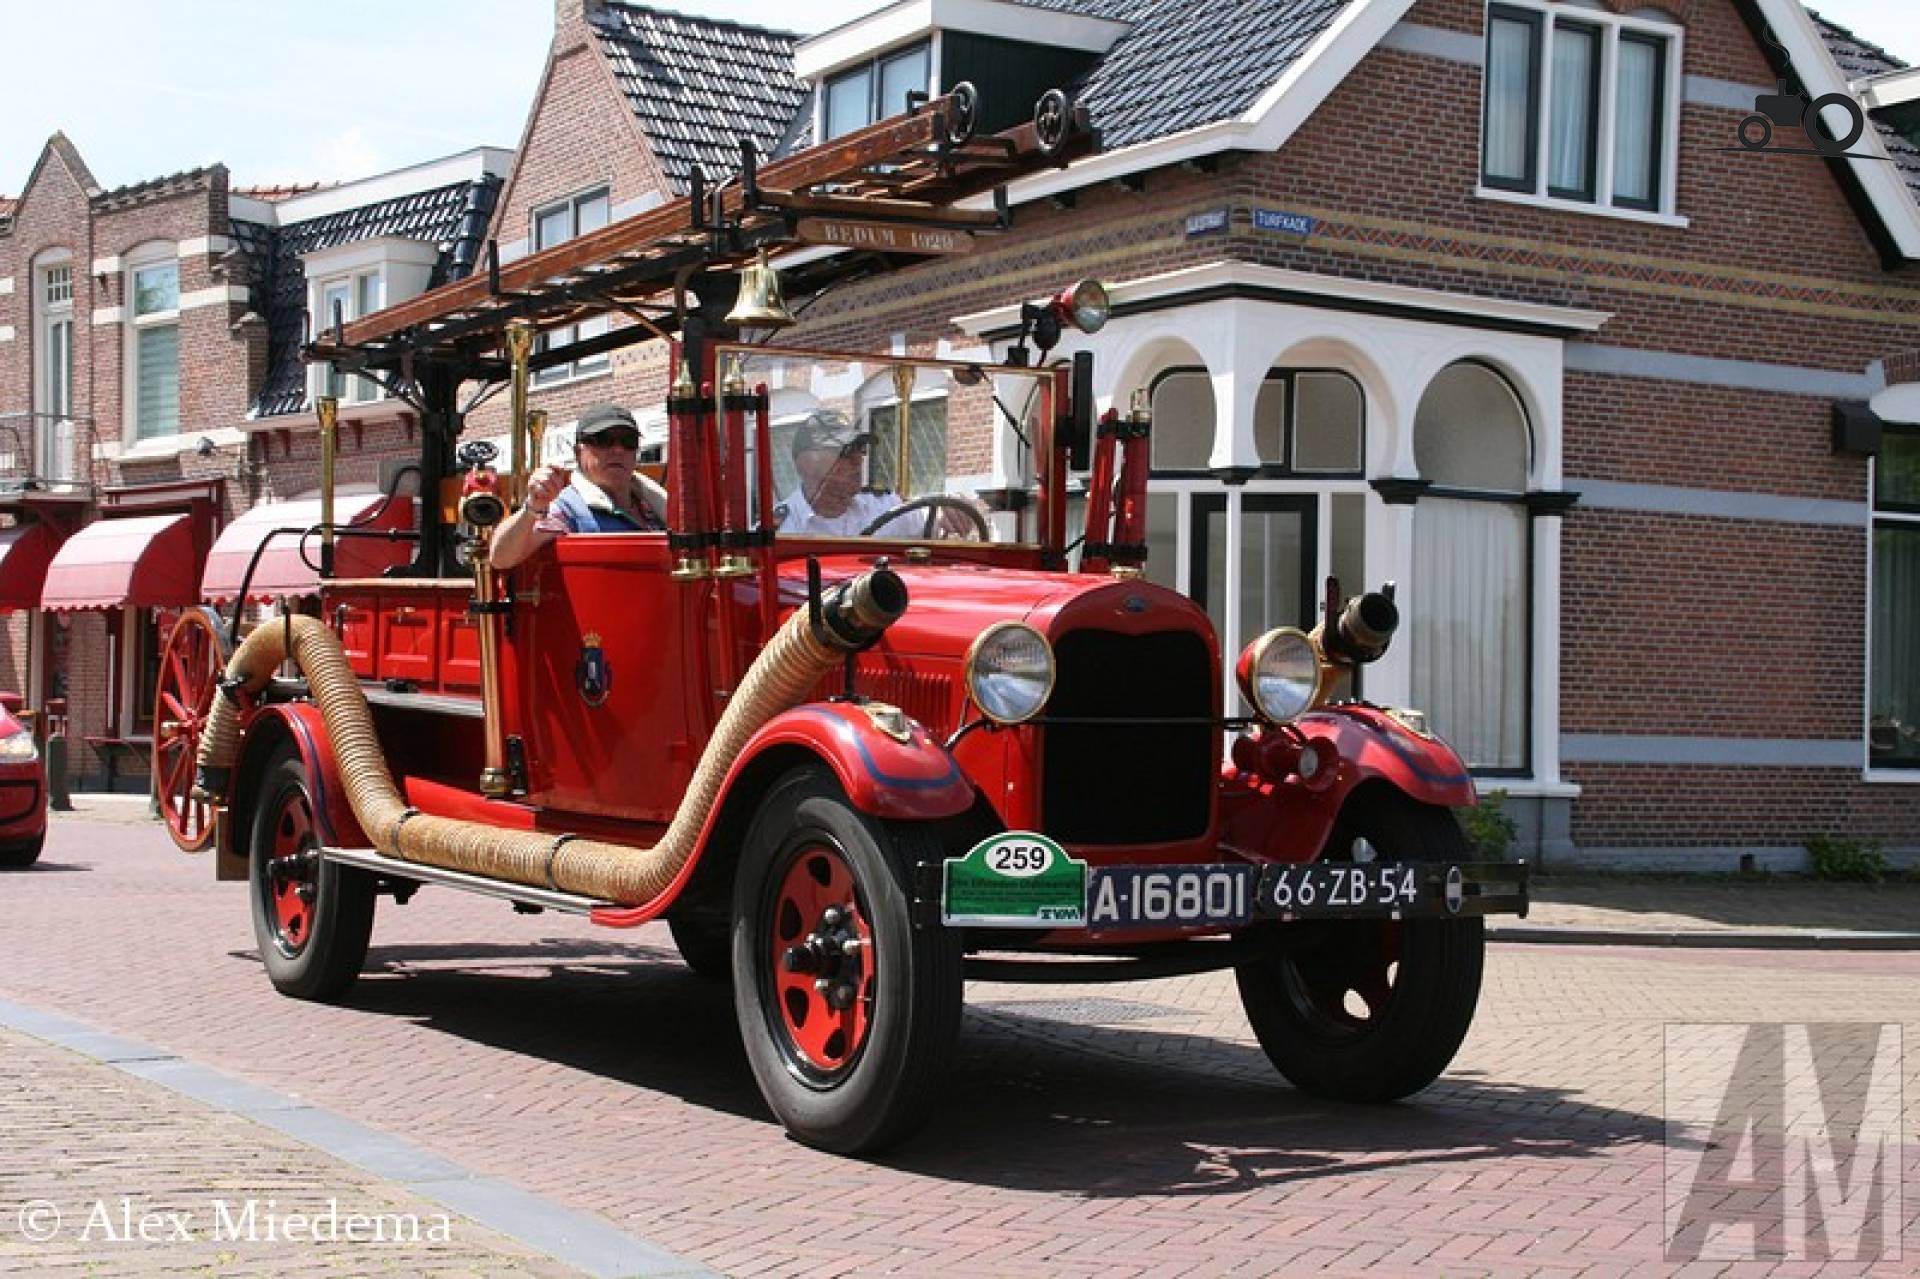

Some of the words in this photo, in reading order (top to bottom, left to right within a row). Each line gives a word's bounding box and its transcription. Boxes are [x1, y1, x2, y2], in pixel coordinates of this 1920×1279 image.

[1259, 211, 1308, 232] TURFKADE
[824, 223, 896, 246] BEDUM
[995, 846, 1045, 869] 259
[1092, 873, 1244, 922] A-16801
[1273, 868, 1417, 905] 66-ZB-54
